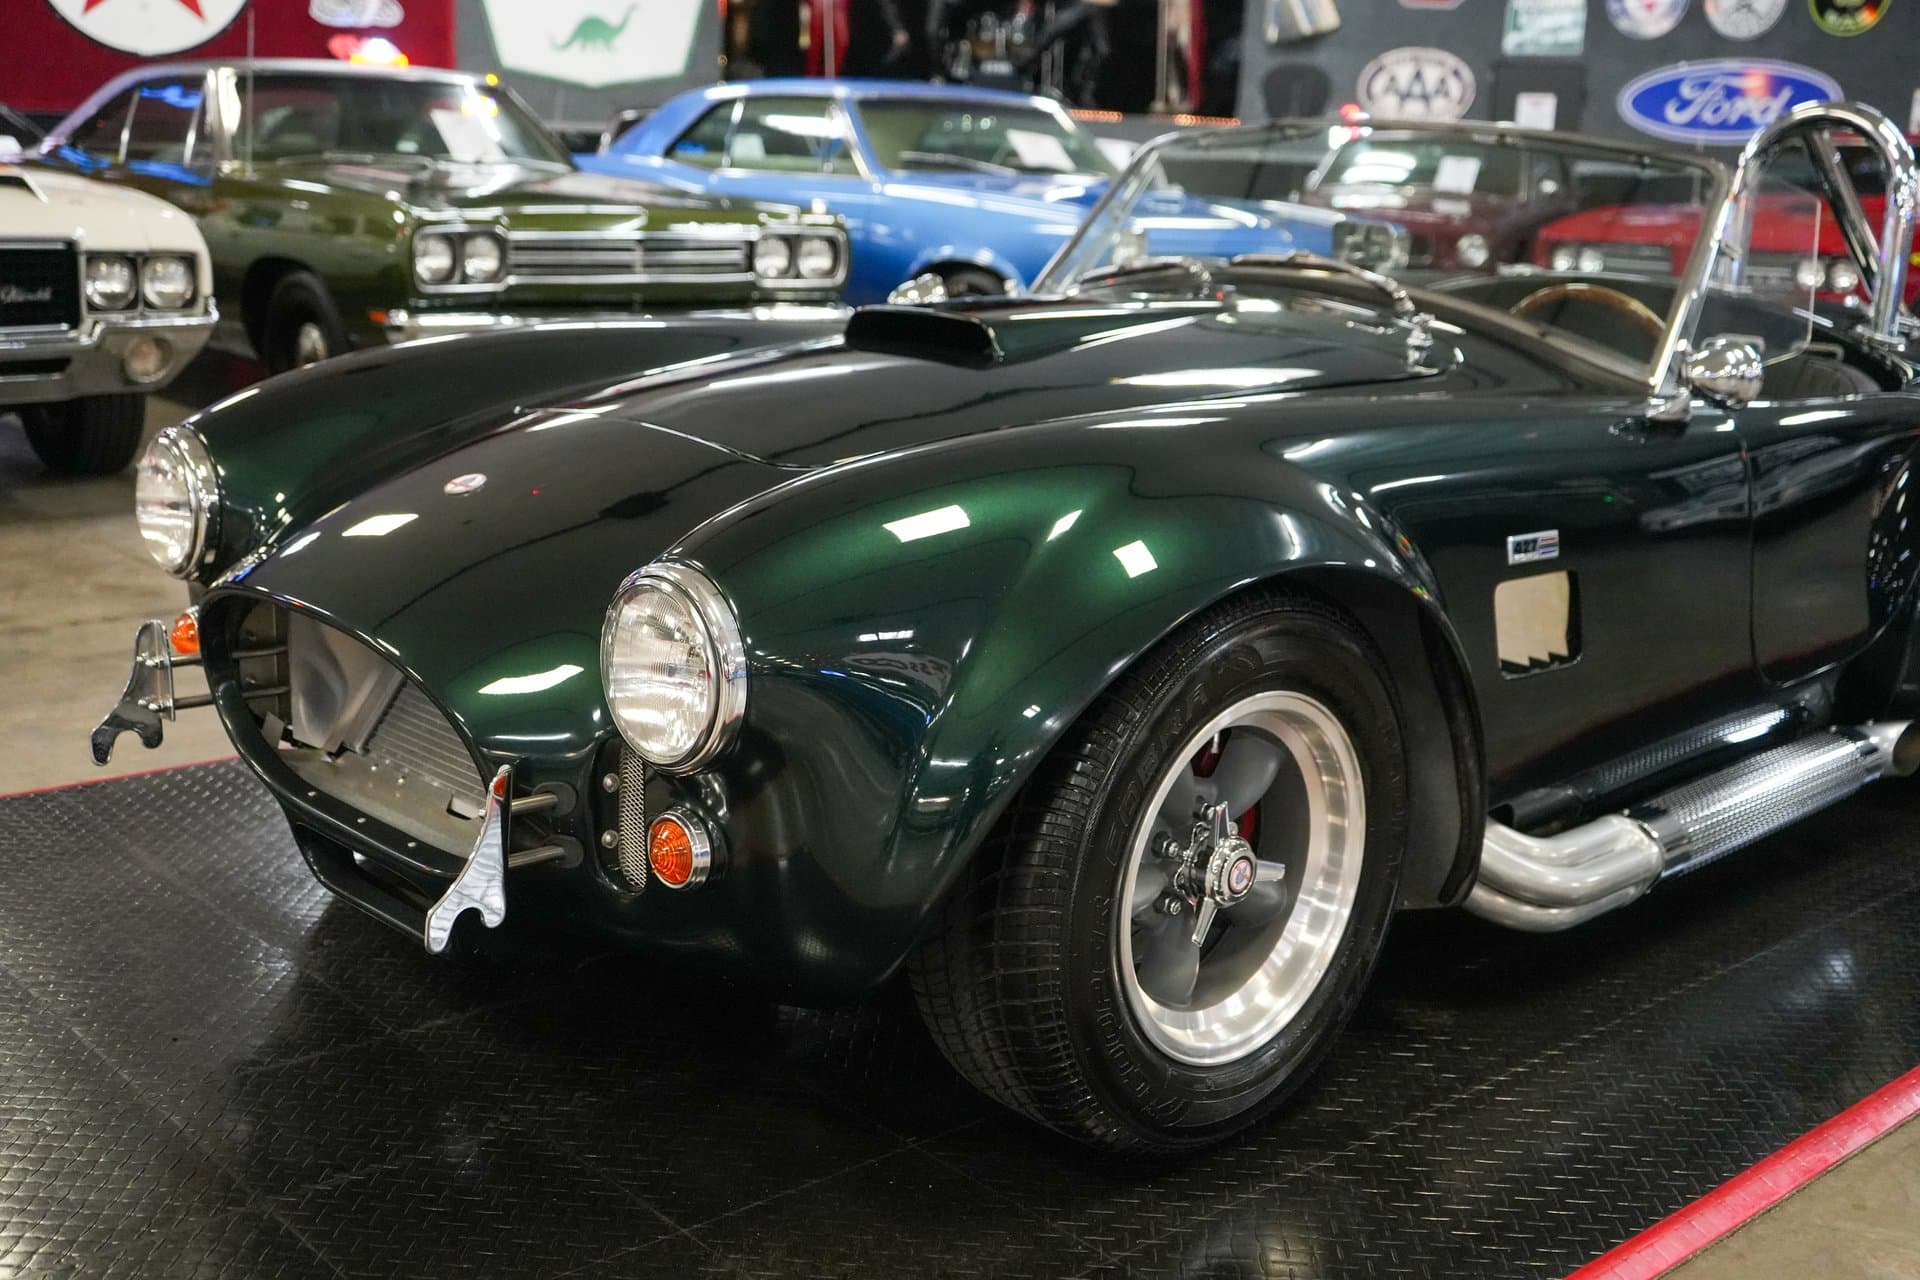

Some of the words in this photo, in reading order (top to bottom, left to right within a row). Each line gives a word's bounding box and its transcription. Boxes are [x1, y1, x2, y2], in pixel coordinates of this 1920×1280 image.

[1382, 68, 1452, 110] AAA
[1664, 74, 1794, 126] Ford
[1514, 538, 1538, 554] 427
